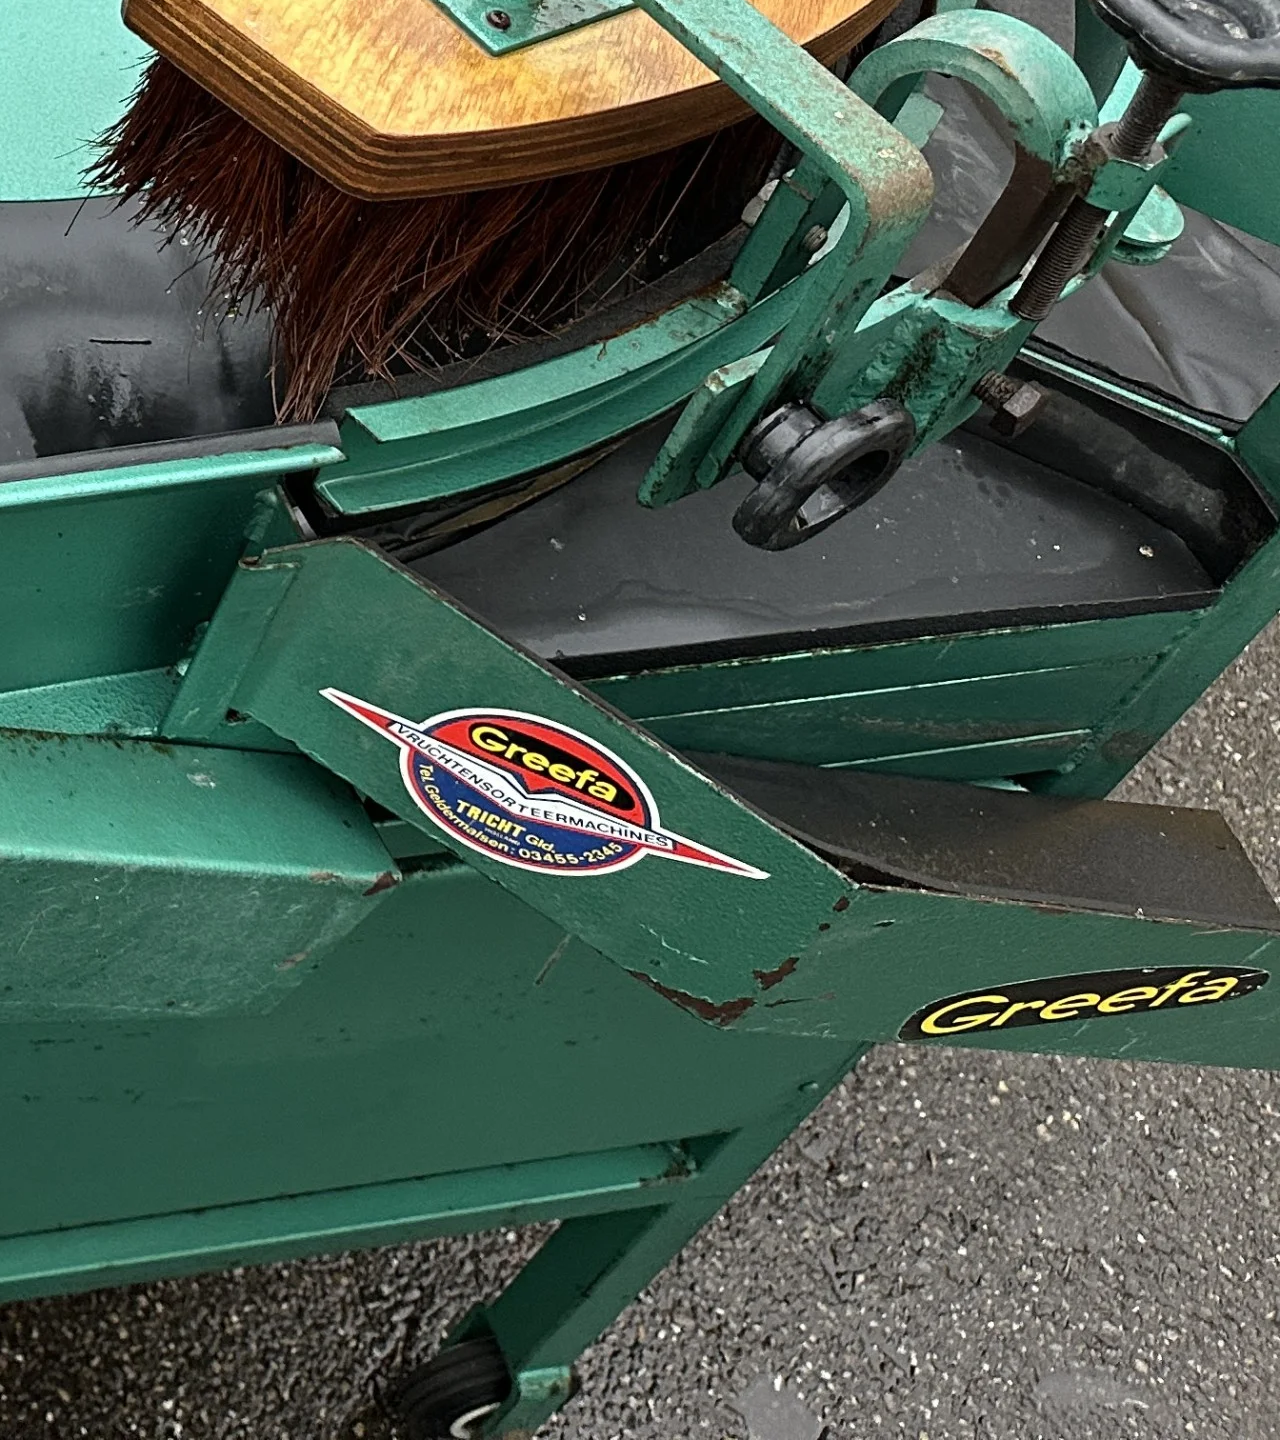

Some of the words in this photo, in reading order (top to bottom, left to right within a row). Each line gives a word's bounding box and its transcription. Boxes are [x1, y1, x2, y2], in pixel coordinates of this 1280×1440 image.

[397, 723, 669, 847] VRUCHTENSORTEERMACHINES
[472, 725, 618, 803] Greefa
[456, 798, 527, 836] TRICHT
[525, 833, 557, 854] Gld.
[518, 841, 624, 865] 03455-2345
[920, 971, 1239, 1034] Greefa
